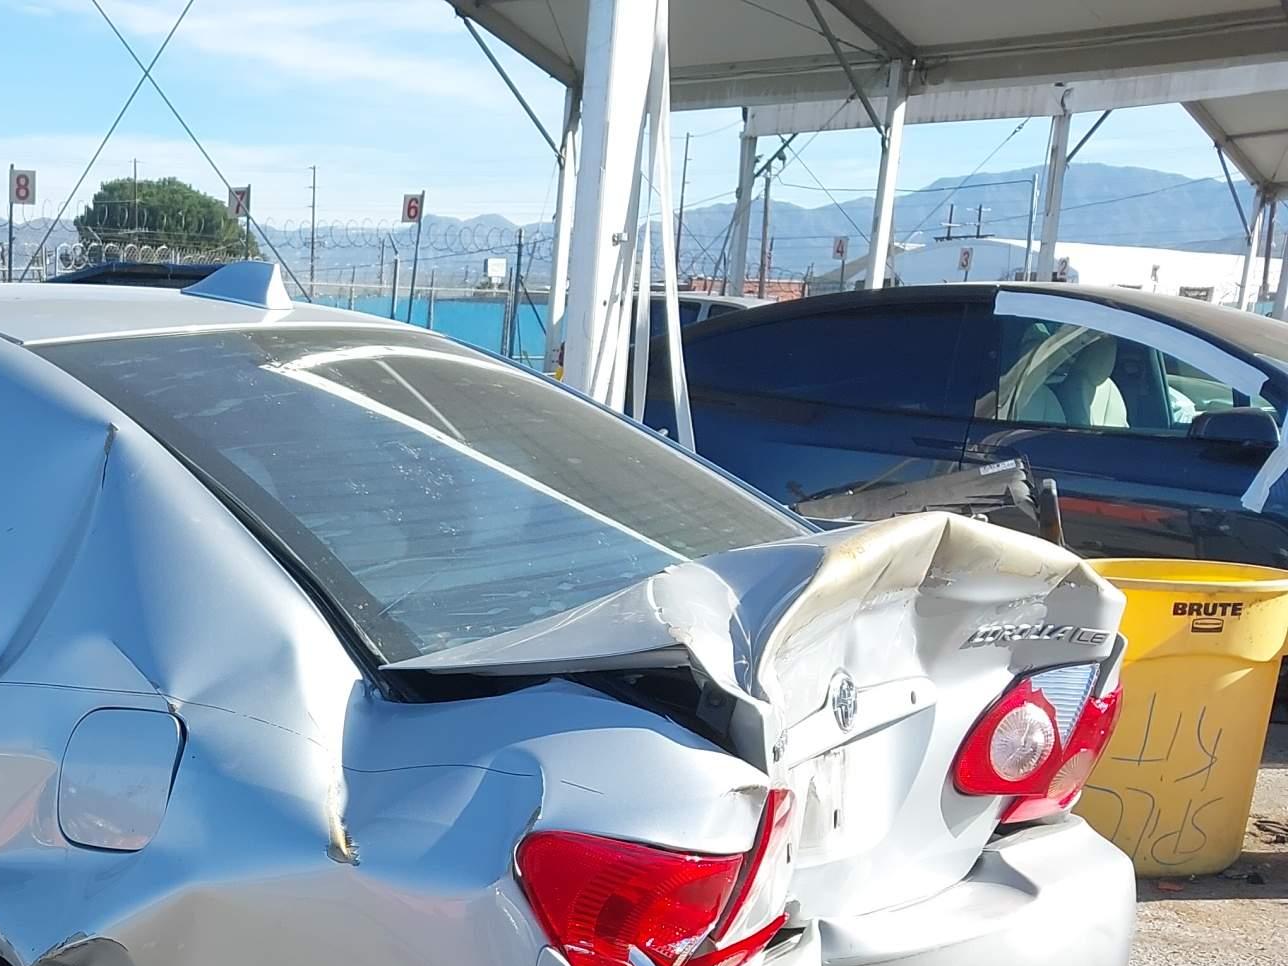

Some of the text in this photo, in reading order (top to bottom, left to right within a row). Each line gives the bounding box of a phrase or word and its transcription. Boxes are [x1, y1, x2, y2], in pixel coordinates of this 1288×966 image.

[16, 174, 29, 200] 8
[235, 191, 246, 214] 7
[407, 198, 419, 219] 6
[836, 240, 845, 257] 4
[962, 251, 970, 267] 3
[1059, 260, 1067, 276] 2
[1173, 602, 1243, 616] BRUTE
[962, 622, 1109, 647] COROLLA LE
